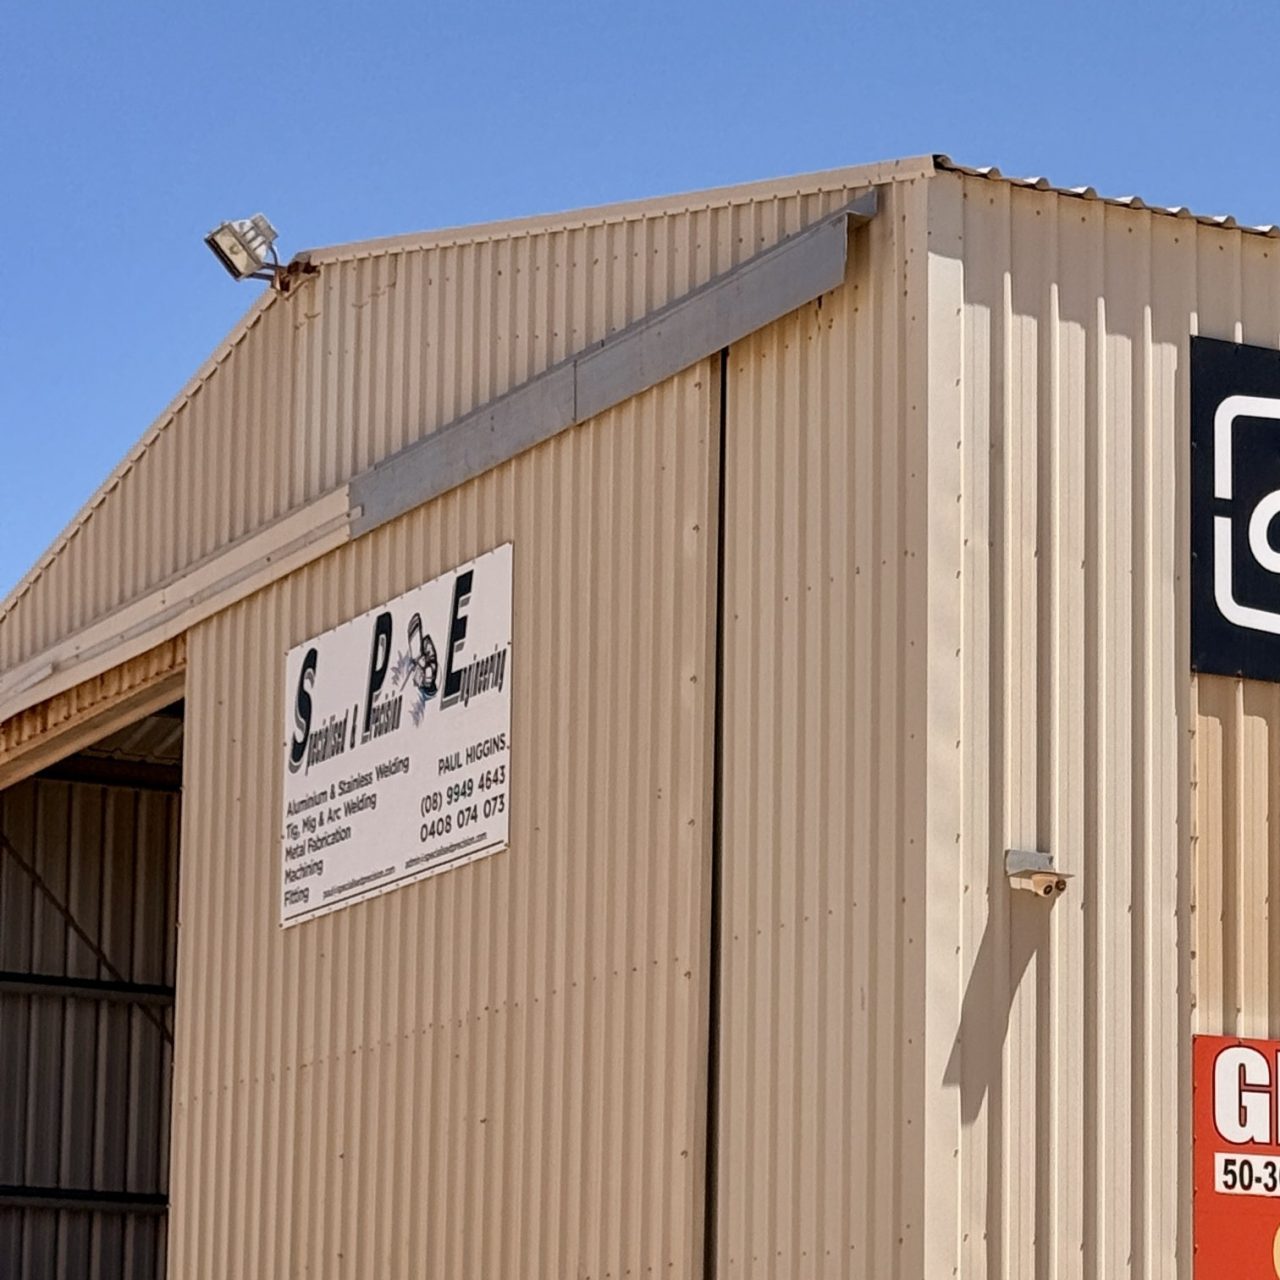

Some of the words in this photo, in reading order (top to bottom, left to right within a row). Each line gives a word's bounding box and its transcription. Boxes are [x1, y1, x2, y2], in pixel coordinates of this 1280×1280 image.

[361, 611, 402, 745] Precision
[440, 569, 507, 711] Engineering
[438, 752, 463, 776] PAUL
[466, 733, 506, 765] HIGGINS
[287, 789, 328, 817] Aluminium
[330, 784, 336, 800] &
[338, 772, 373, 796] Stainless
[375, 756, 410, 781] Welding
[420, 791, 443, 818] (08)
[446, 778, 474, 806] 9949
[478, 765, 506, 792] 4643
[302, 815, 316, 834] Mig
[318, 811, 325, 827] &
[327, 807, 341, 823] Arc
[343, 793, 377, 818] Welding
[420, 815, 452, 843] 0408
[457, 804, 478, 829] 074
[483, 793, 505, 819] 073
[285, 839, 306, 862] Metal
[307, 825, 351, 855] Fabrication
[285, 858, 323, 885] Machining
[284, 886, 310, 907] Fitting
